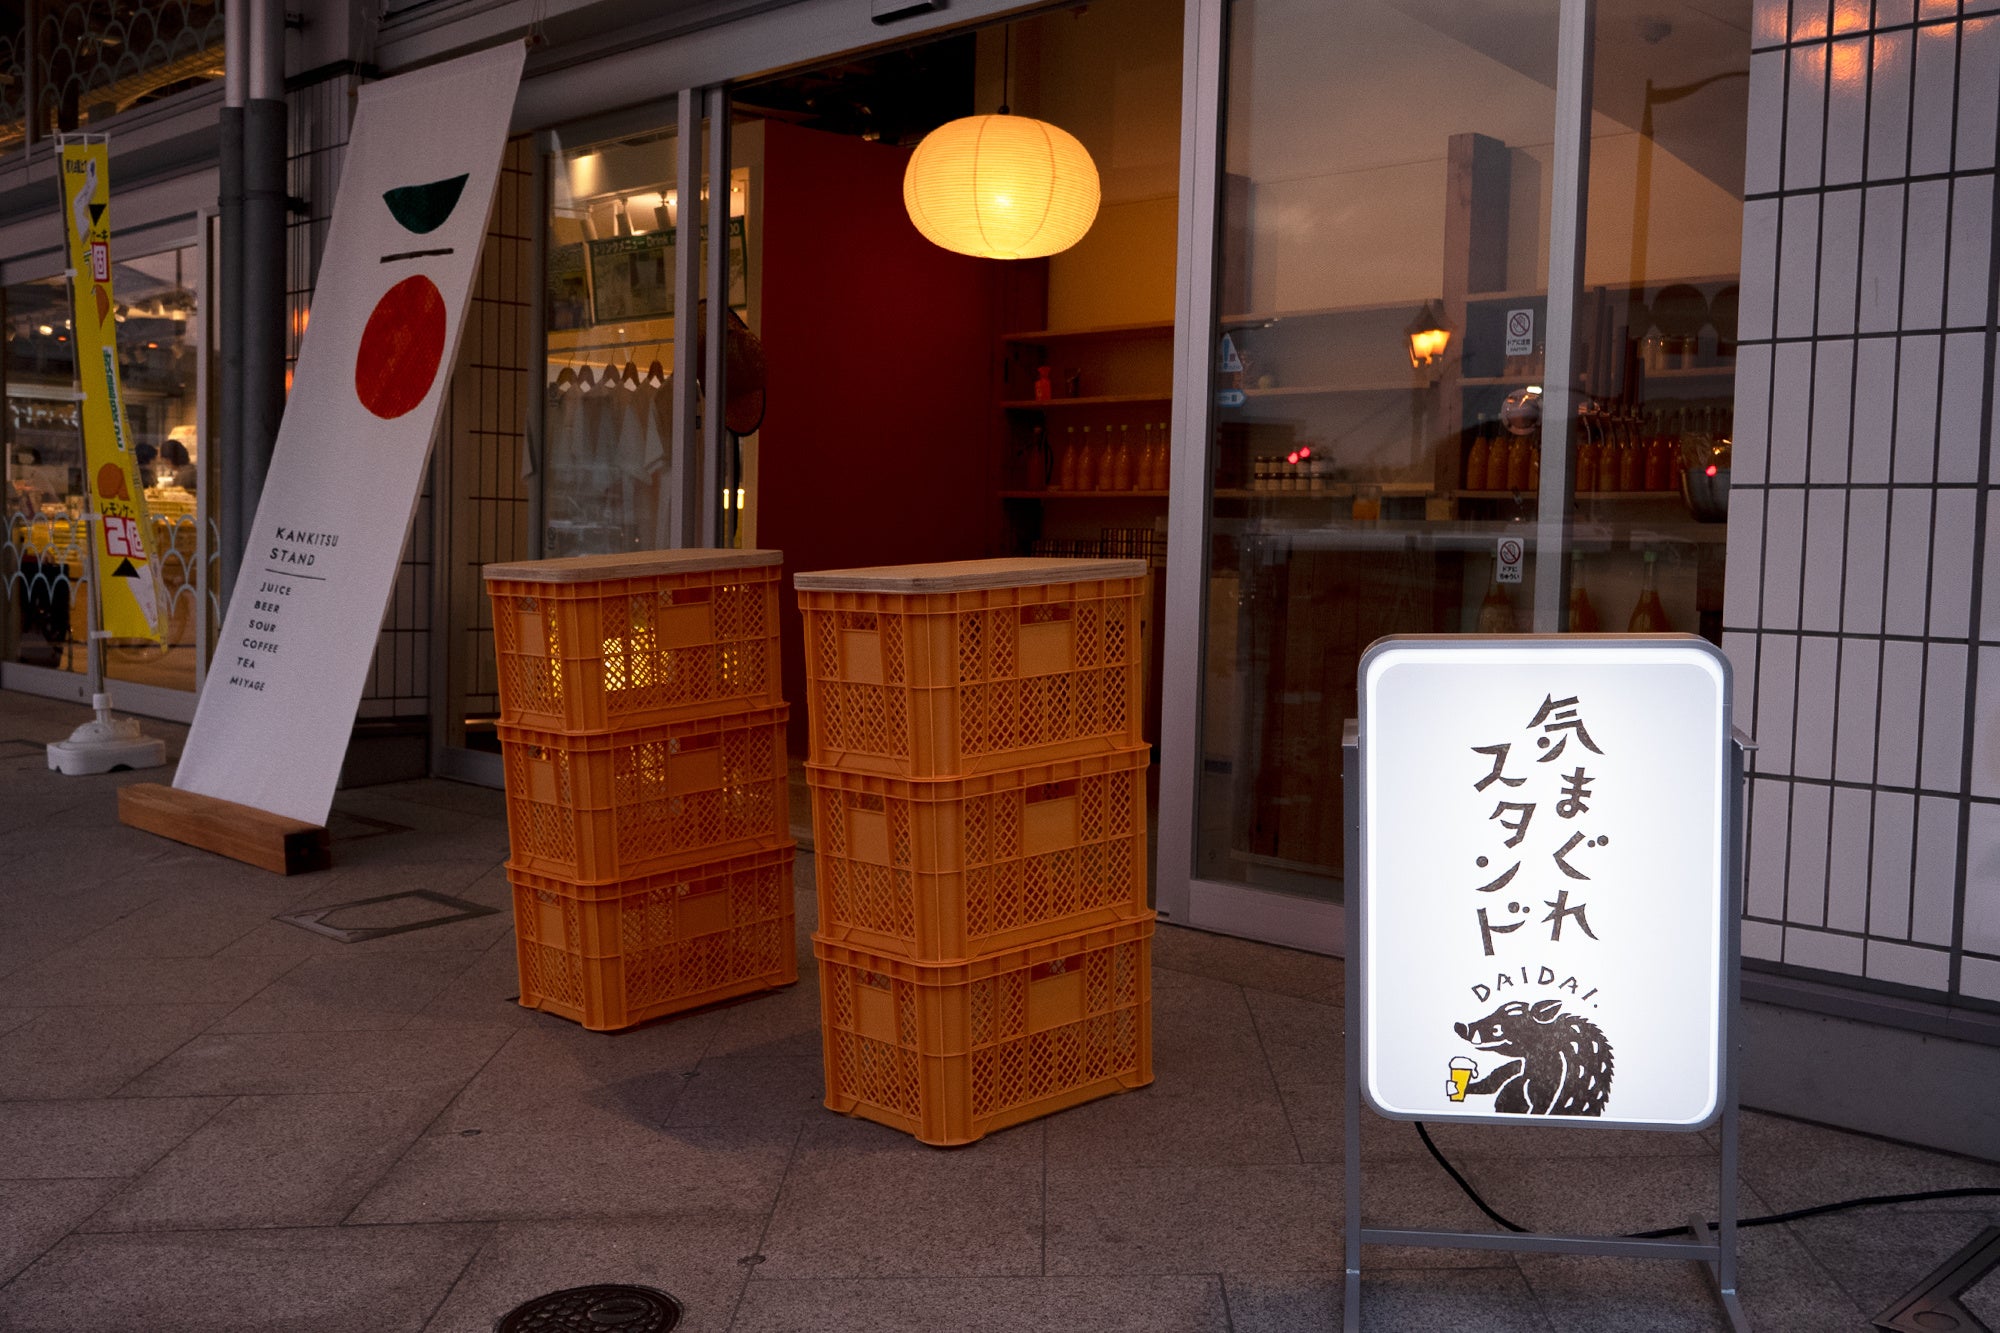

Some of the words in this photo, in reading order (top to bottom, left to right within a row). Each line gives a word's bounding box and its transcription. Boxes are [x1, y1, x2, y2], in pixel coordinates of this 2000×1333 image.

[276, 527, 339, 547] KANKITSU
[269, 547, 315, 566] STAND
[260, 582, 292, 596] JUICE
[254, 600, 280, 614] BEER
[249, 619, 276, 632] SOUR
[242, 638, 279, 653] COFFEE
[237, 657, 255, 669] TEA
[229, 676, 266, 692] MIYAGE
[1526, 692, 1609, 942] 気まぐれ
[1470, 742, 1537, 957] スタンド
